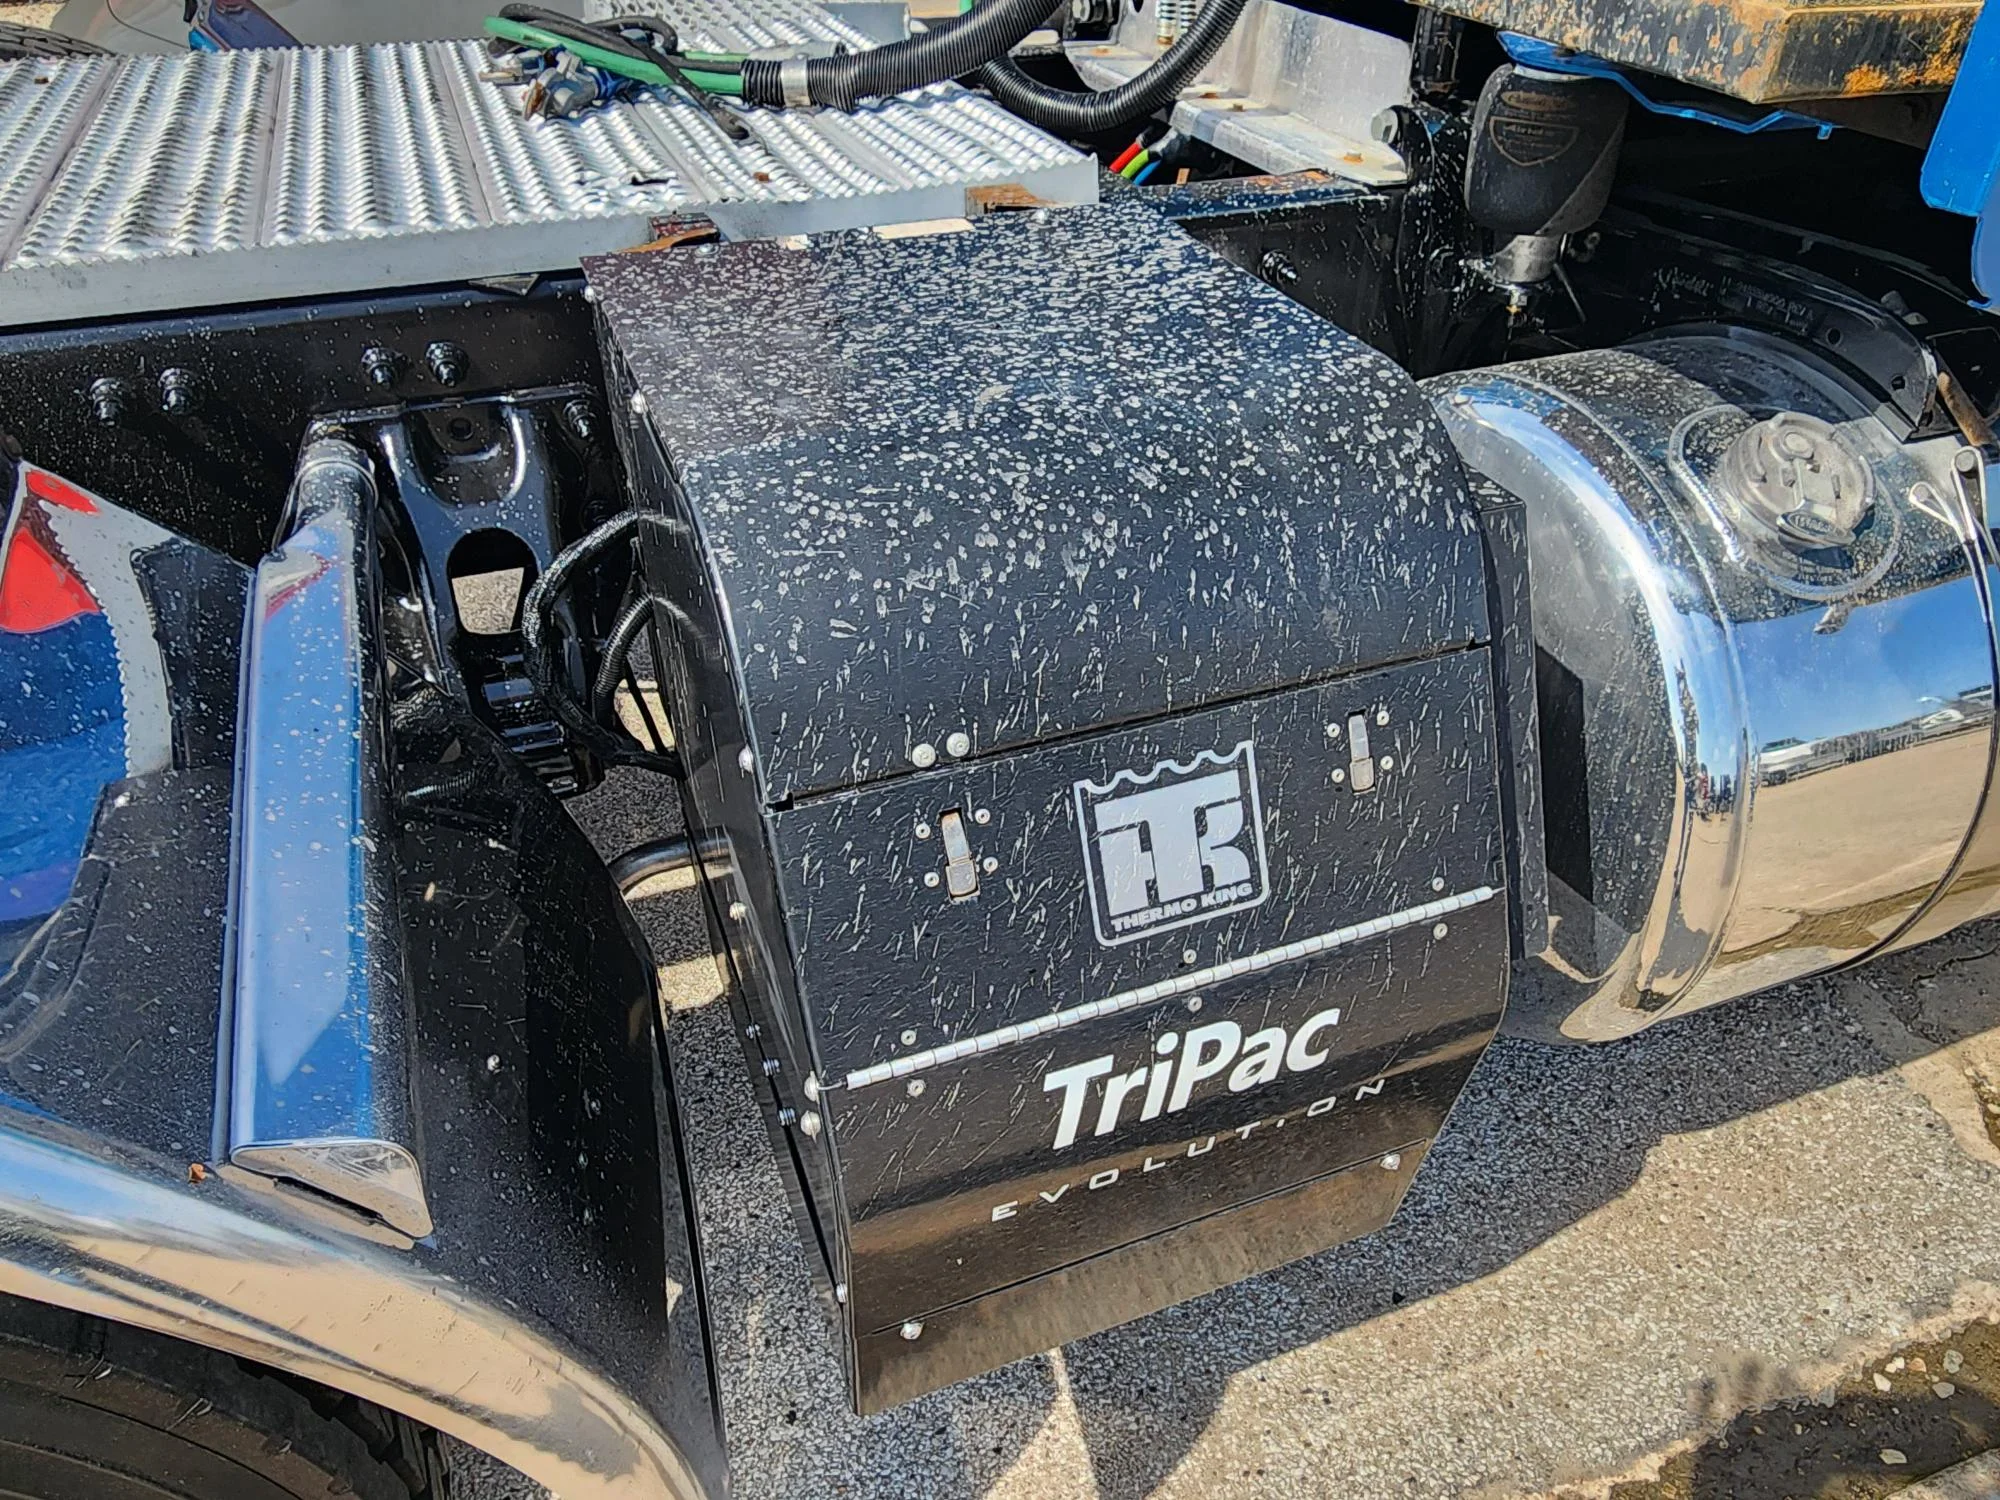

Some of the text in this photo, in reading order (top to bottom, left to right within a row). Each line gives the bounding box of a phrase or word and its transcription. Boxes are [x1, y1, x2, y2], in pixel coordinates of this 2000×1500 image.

[1110, 882, 1254, 932] THERMO KING
[1043, 1008, 1341, 1150] TriPac
[991, 1079, 1385, 1222] EVOLUTION
